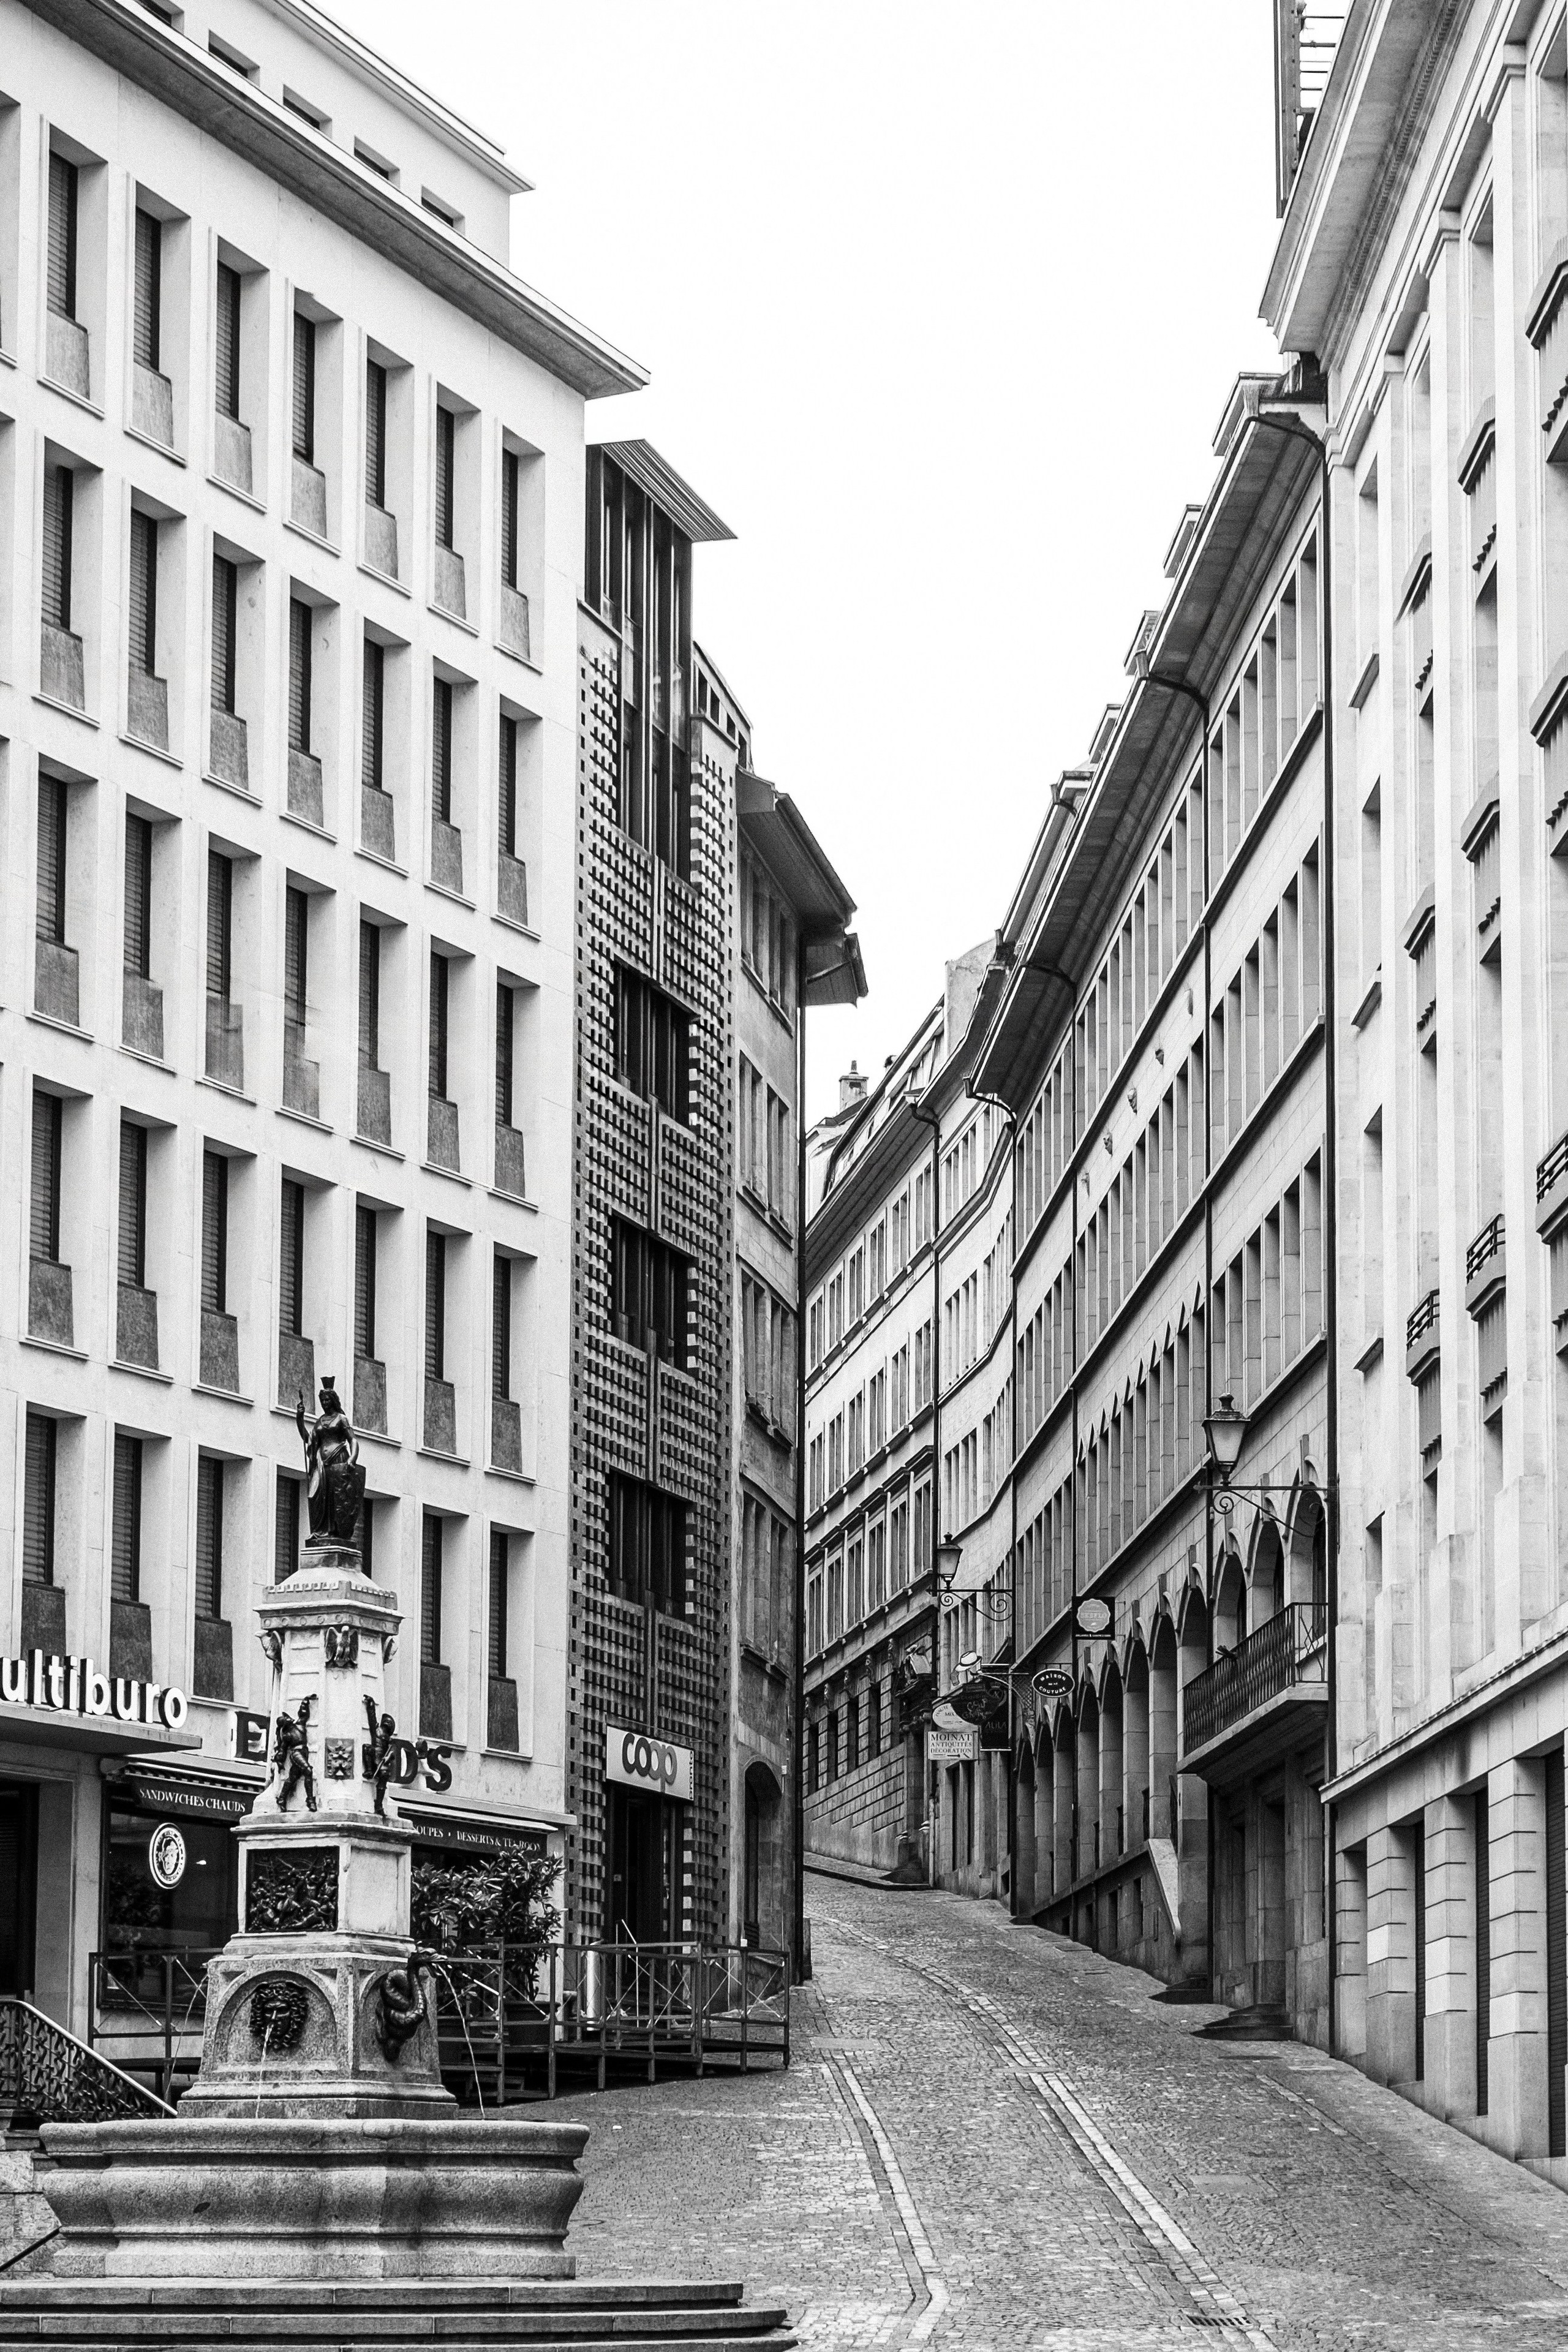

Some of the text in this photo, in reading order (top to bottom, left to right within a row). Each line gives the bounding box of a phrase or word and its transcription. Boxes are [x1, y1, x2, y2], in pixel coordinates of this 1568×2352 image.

[1040, 1673, 1066, 1681] MAISON
[0, 1649, 187, 1729] ultiburo
[1039, 1686, 1066, 1694] COUTURE
[139, 1789, 246, 1812] SANDWICHES CHAUDS
[456, 1831, 494, 1846] DESSERTS
[495, 1838, 502, 1846] &
